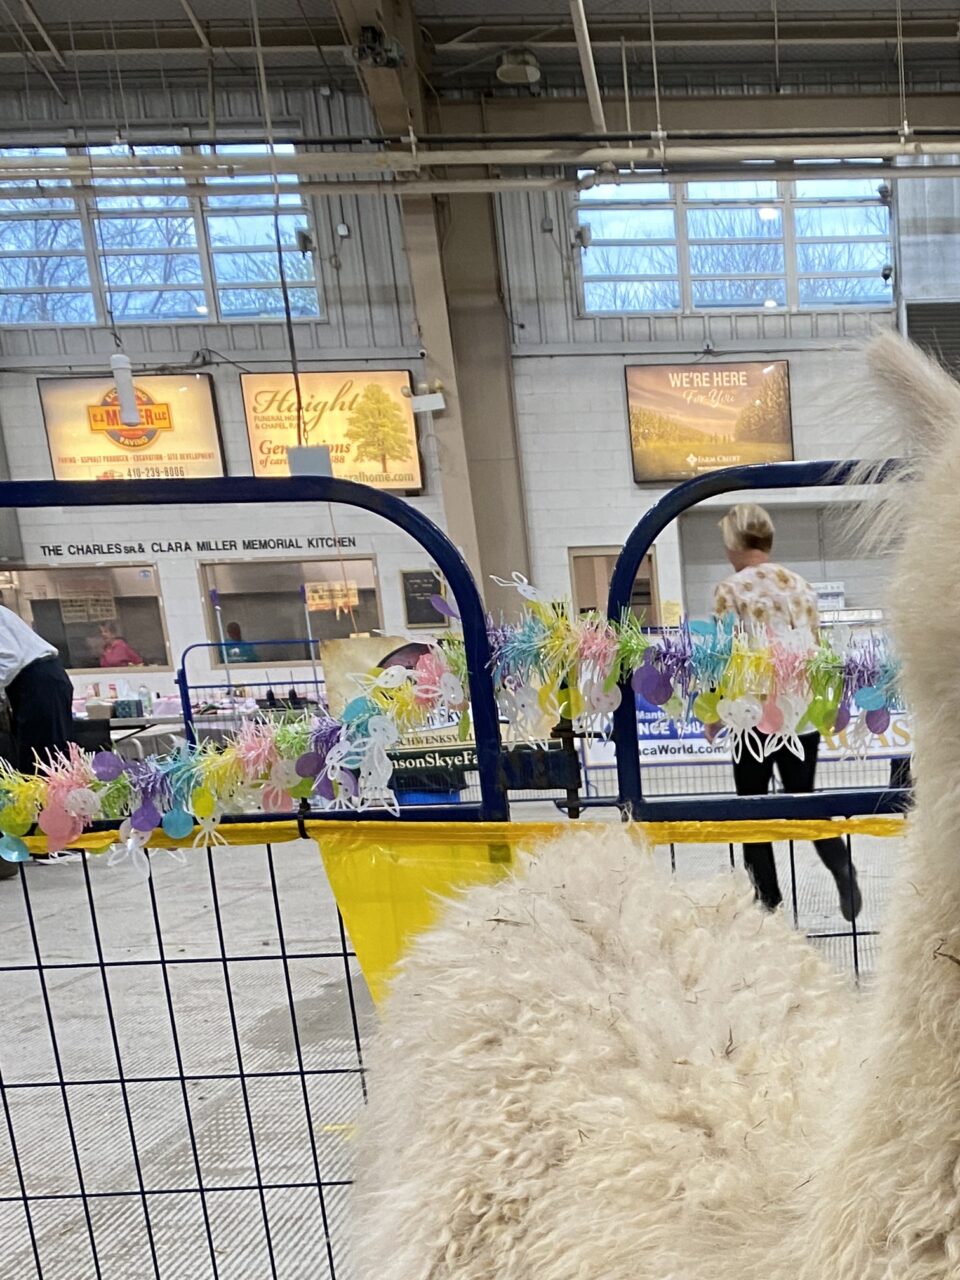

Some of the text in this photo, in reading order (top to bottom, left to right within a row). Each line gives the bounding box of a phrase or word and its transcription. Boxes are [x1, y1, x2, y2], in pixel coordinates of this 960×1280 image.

[668, 371, 748, 388] WE'RE HERE
[252, 380, 359, 431] Haight
[253, 415, 284, 423] FUNERAL
[40, 544, 64, 556] THE
[67, 543, 123, 556] CHARLES
[137, 542, 146, 554] &
[151, 541, 193, 553] CLARA
[196, 540, 238, 551] MILLER
[242, 538, 303, 550] MEMORIAL
[307, 536, 357, 549] KITCHEN
